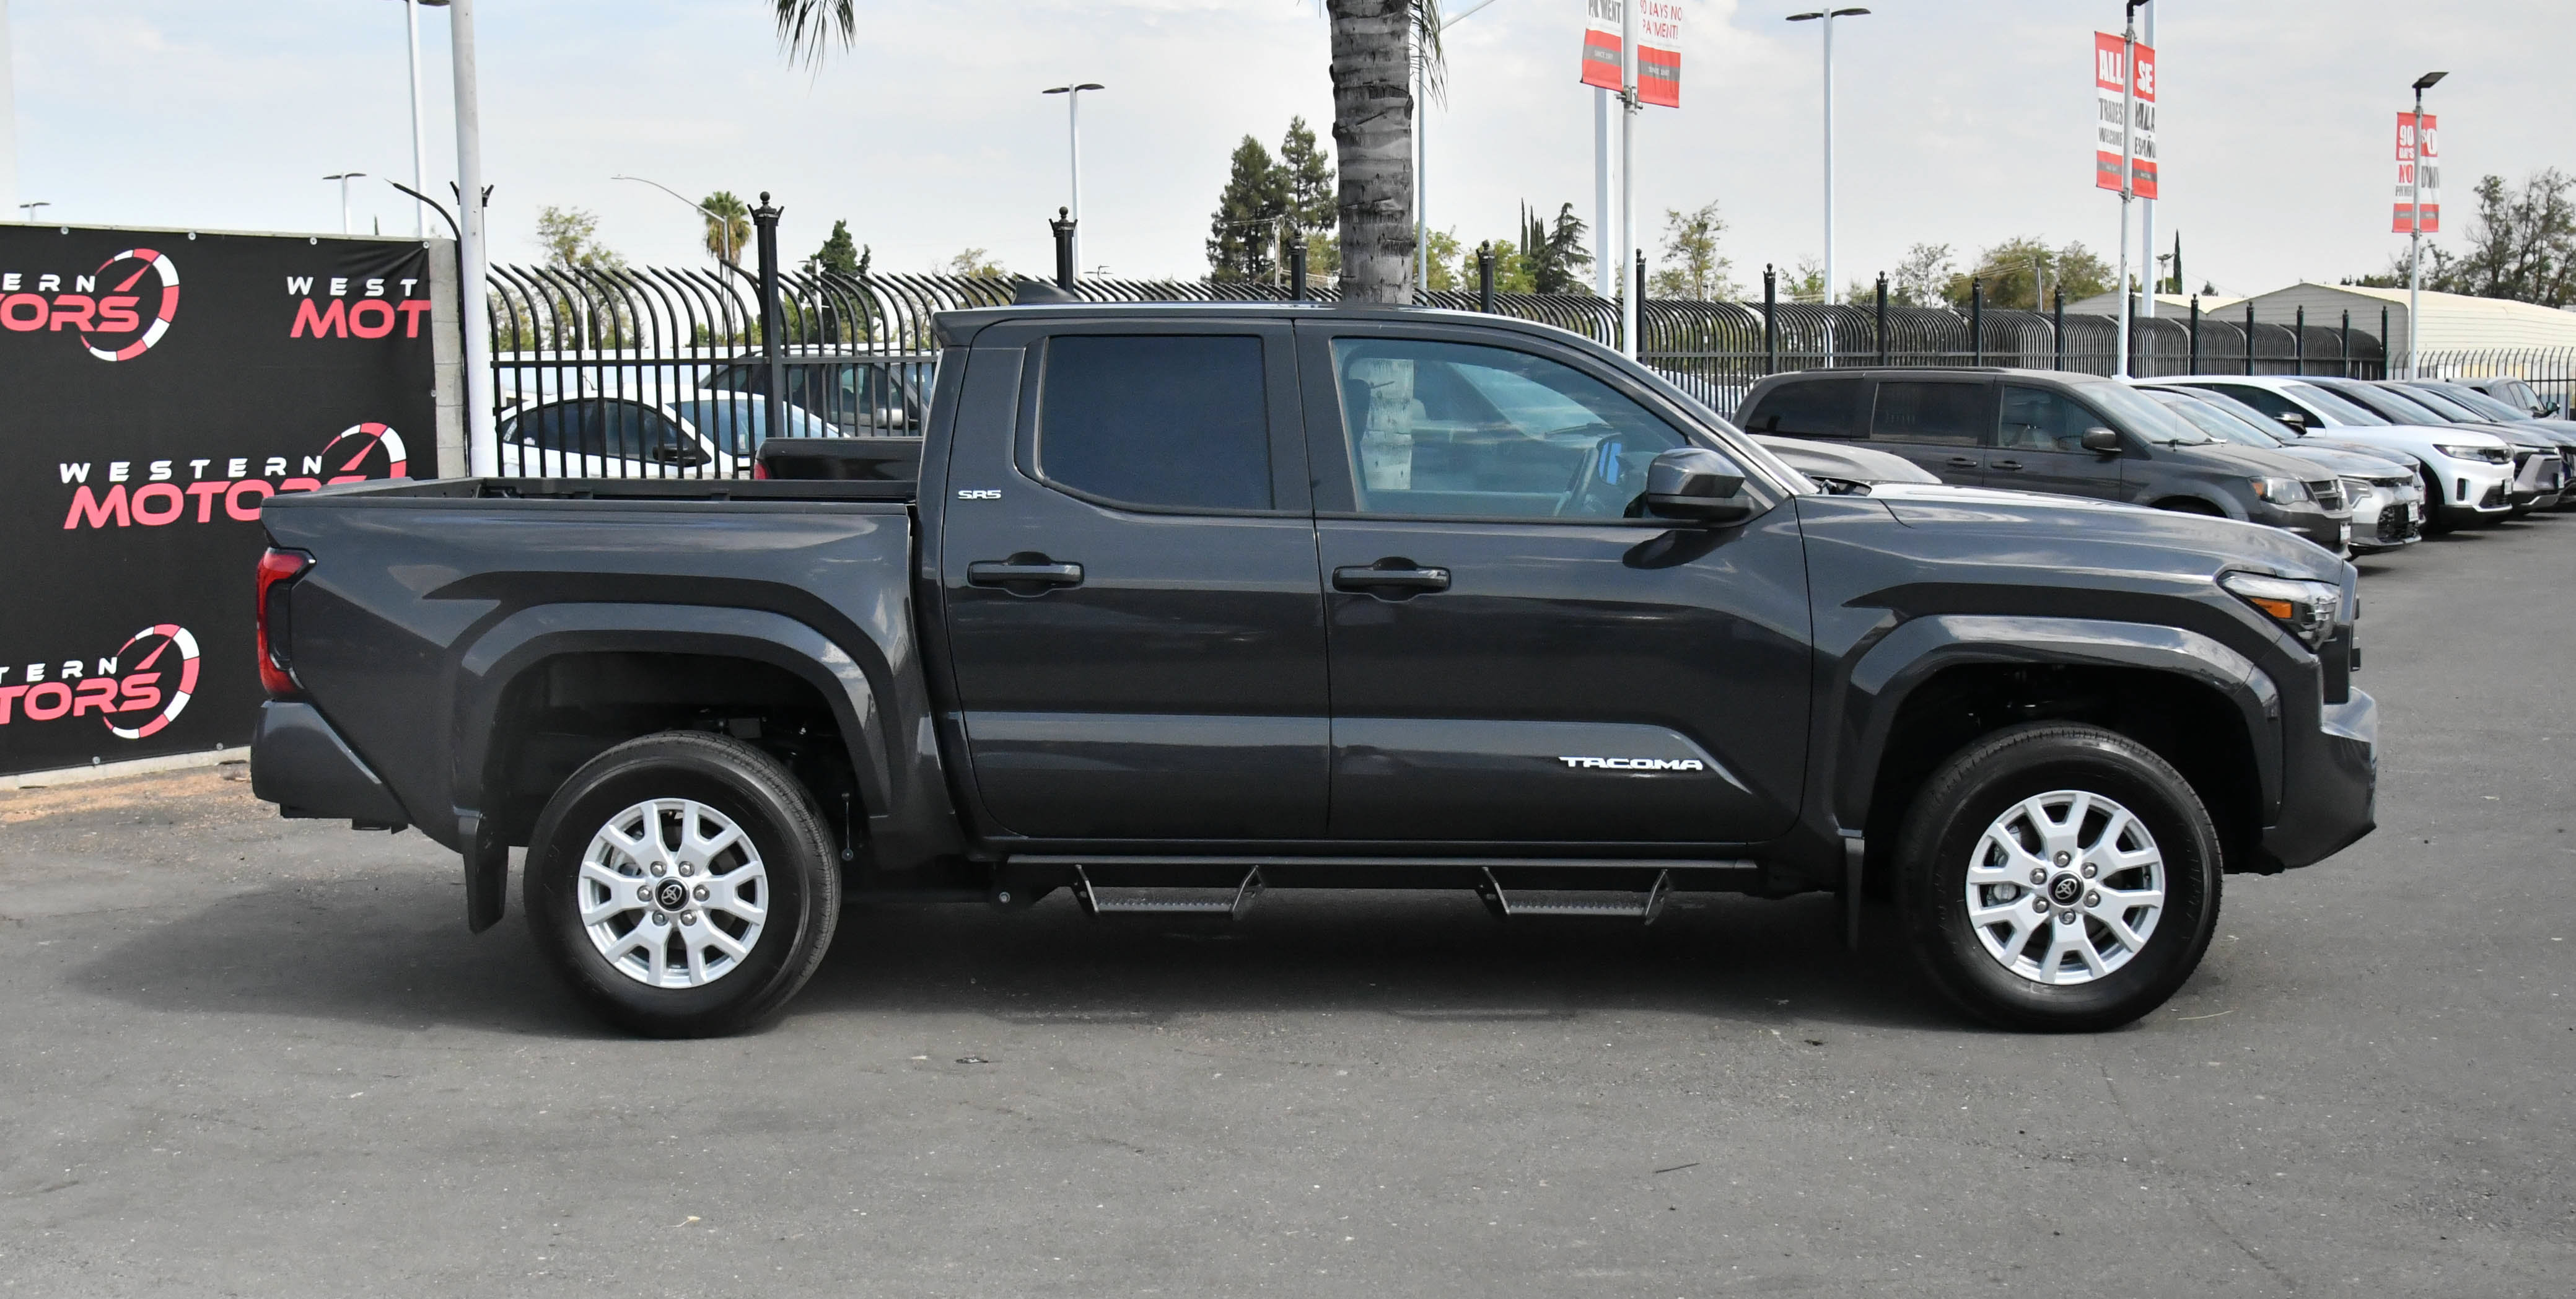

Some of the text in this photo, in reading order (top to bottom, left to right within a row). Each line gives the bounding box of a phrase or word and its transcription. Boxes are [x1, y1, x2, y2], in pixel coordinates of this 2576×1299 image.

[1588, 0, 1621, 24] PAMENT
[1671, 6, 1682, 21] NO
[1642, 19, 1678, 40] PAMENT!
[2098, 49, 2124, 85] ALL
[2137, 60, 2153, 94] SE
[2098, 98, 2123, 125] TRADES
[2399, 125, 2414, 147] 90
[2399, 164, 2413, 183] NO
[287, 276, 418, 297] WEST
[0, 293, 140, 332] ORS
[60, 456, 322, 483] WESTERN
[64, 475, 367, 529] MOTO
[958, 490, 1001, 499] SR5
[1558, 756, 1702, 770] TACOMA
